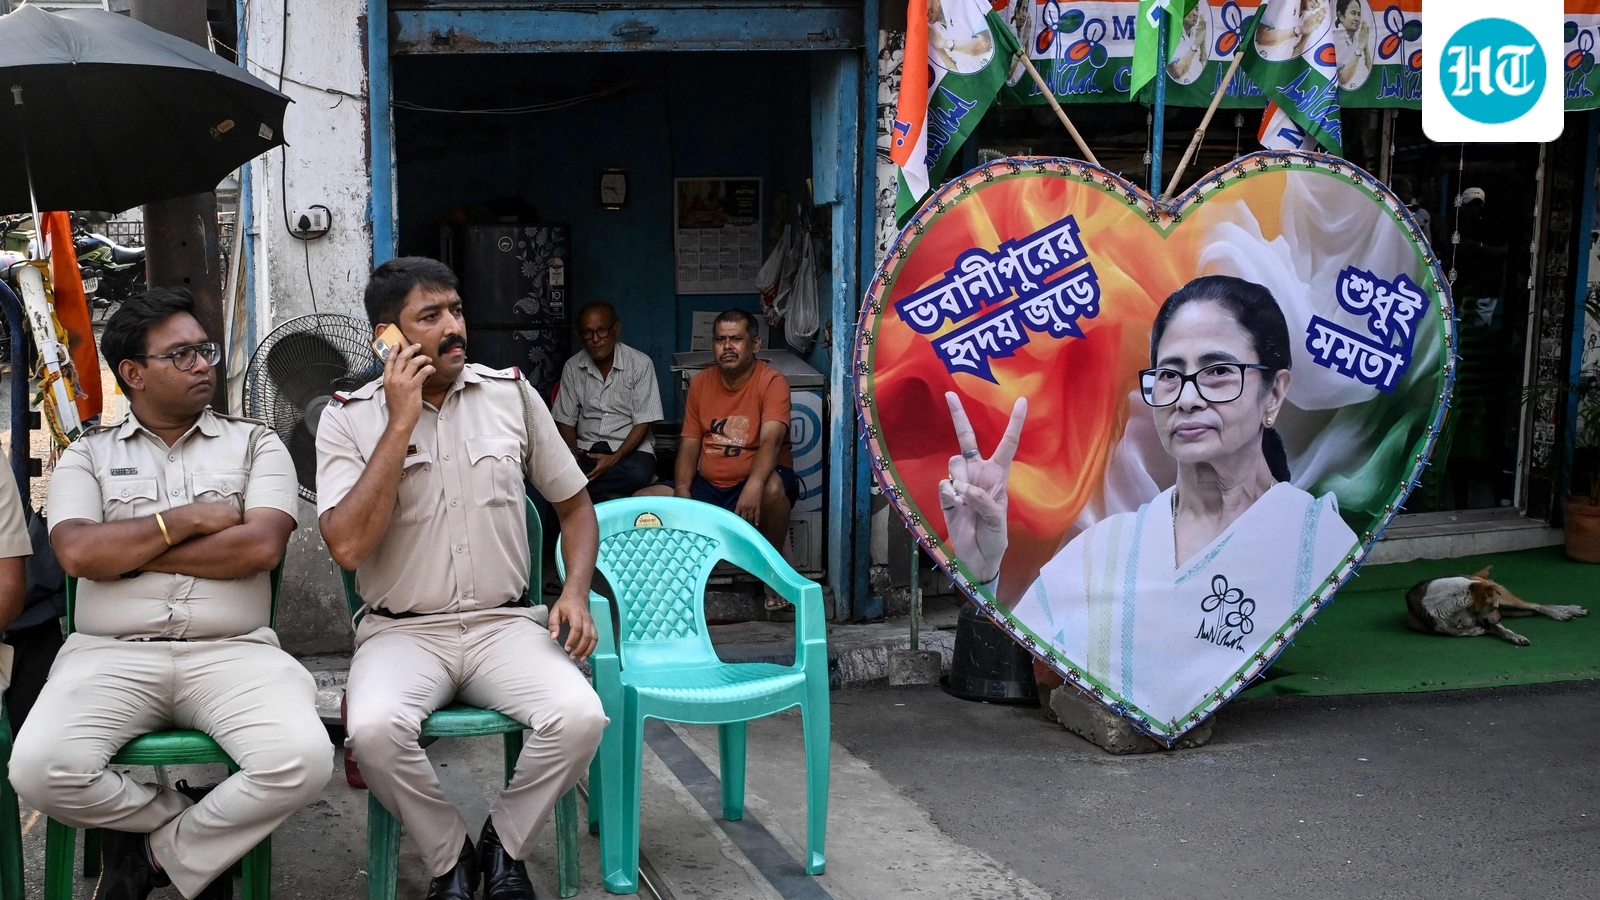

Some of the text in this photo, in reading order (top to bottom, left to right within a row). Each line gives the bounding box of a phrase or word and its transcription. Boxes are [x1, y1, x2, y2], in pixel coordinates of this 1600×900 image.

[902, 223, 1079, 327] ভবানীপুরের
[1341, 273, 1423, 339] শুধুই
[940, 271, 1094, 369] হৃদয় জুড়ে
[1311, 323, 1405, 387] মমতা
